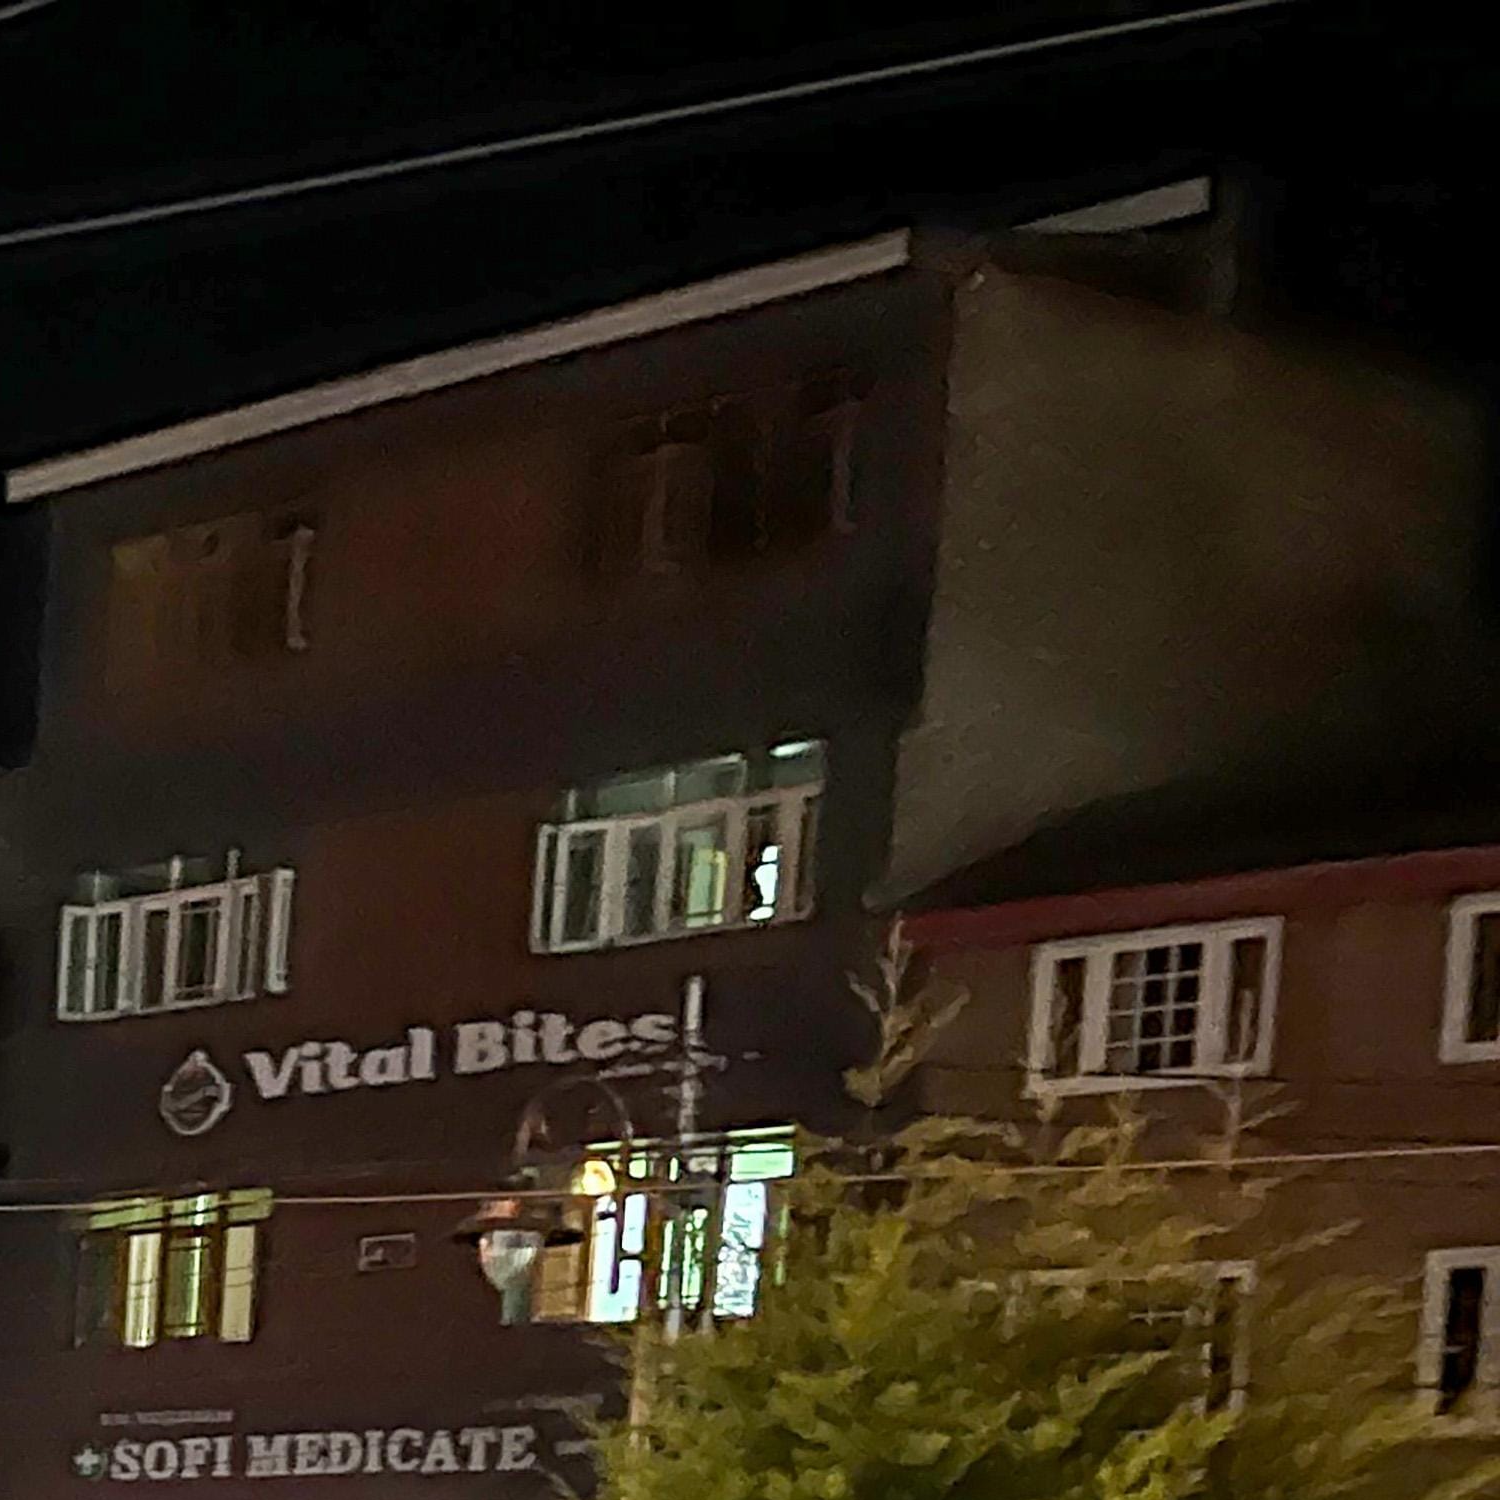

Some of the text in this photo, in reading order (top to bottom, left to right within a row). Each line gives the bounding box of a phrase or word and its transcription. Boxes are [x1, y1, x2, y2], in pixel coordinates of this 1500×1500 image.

[245, 1010, 677, 1099] Vital Bites
[110, 1425, 537, 1480] SOFI MEDICATE
